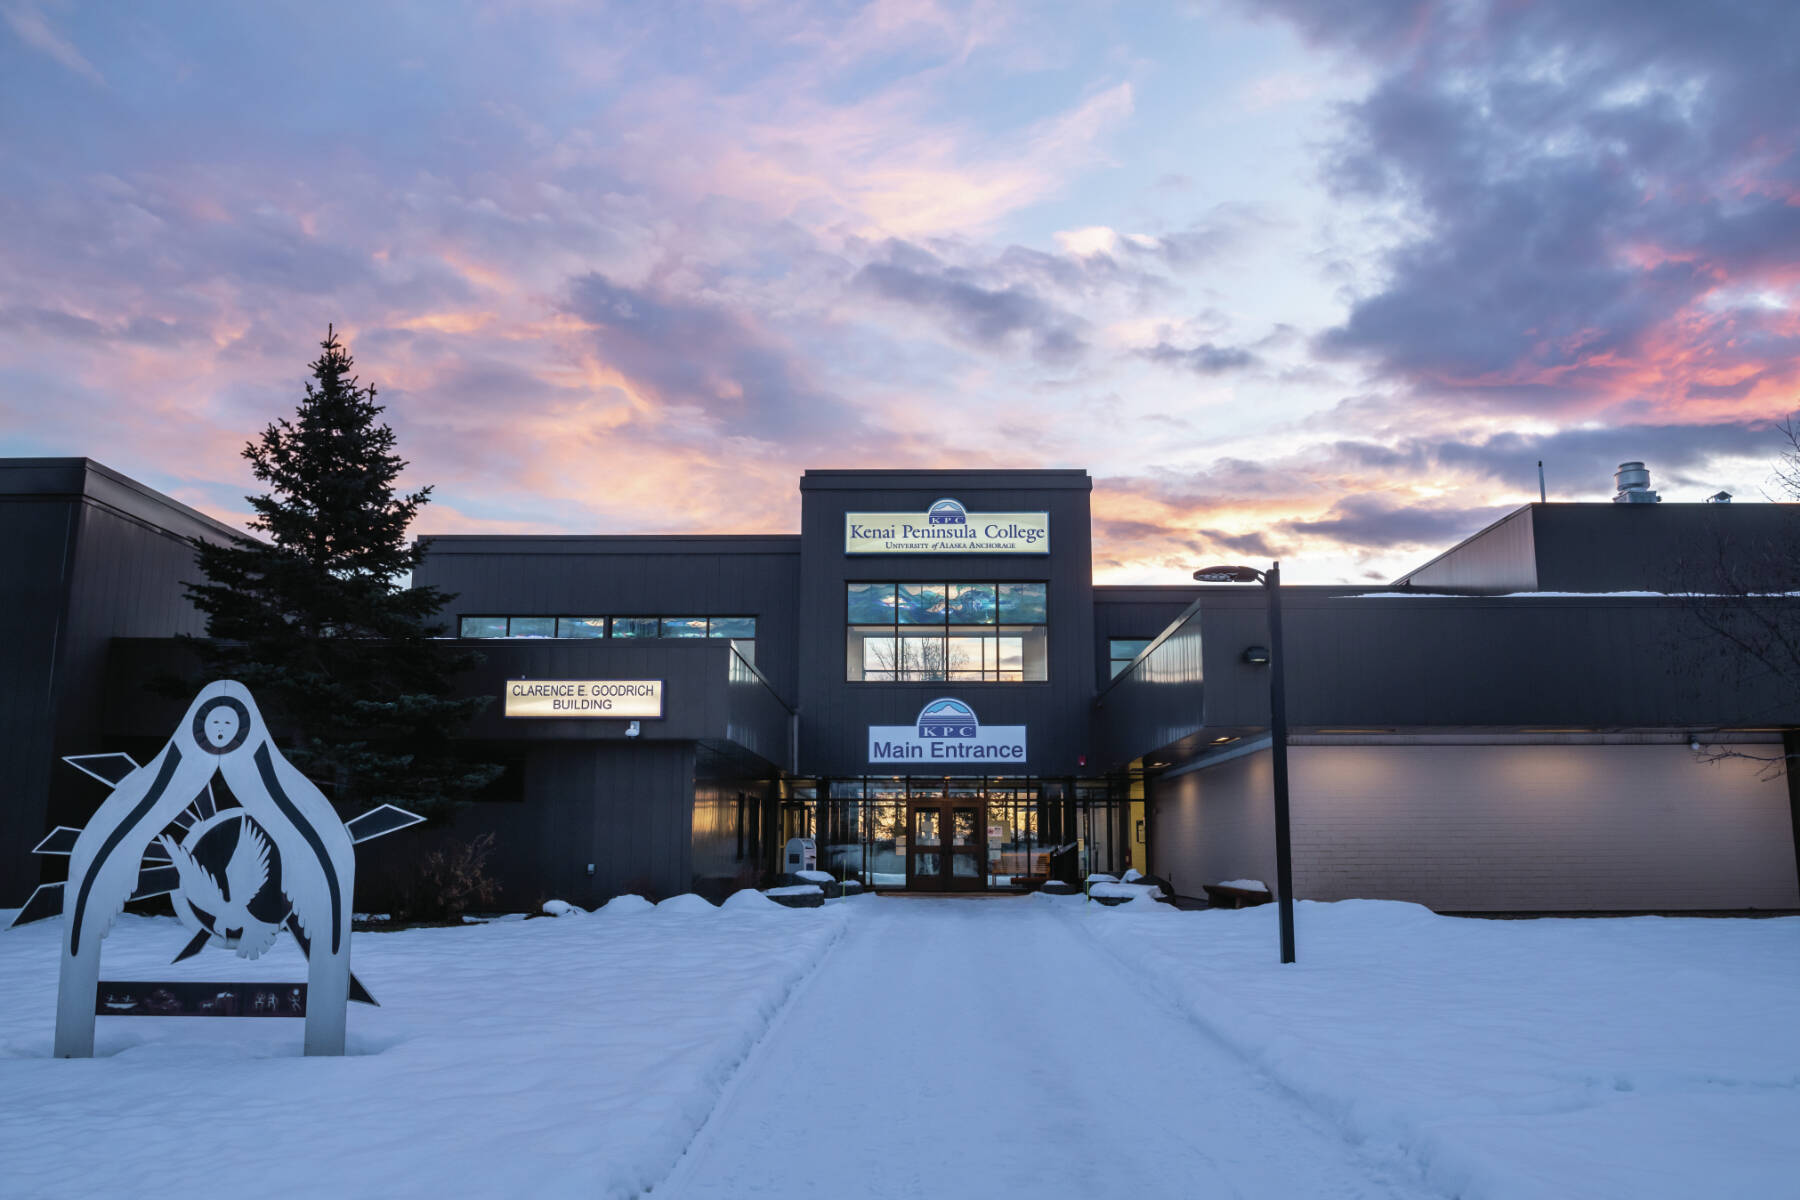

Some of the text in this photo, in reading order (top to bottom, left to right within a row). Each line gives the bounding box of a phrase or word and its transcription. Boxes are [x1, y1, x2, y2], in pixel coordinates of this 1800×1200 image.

[851, 525, 1045, 543] Kenai Peninsula College
[513, 685, 654, 696] CLARENCE E. GOODRICH
[553, 700, 612, 710] BUILDING
[874, 742, 1023, 758] Main Entrance
